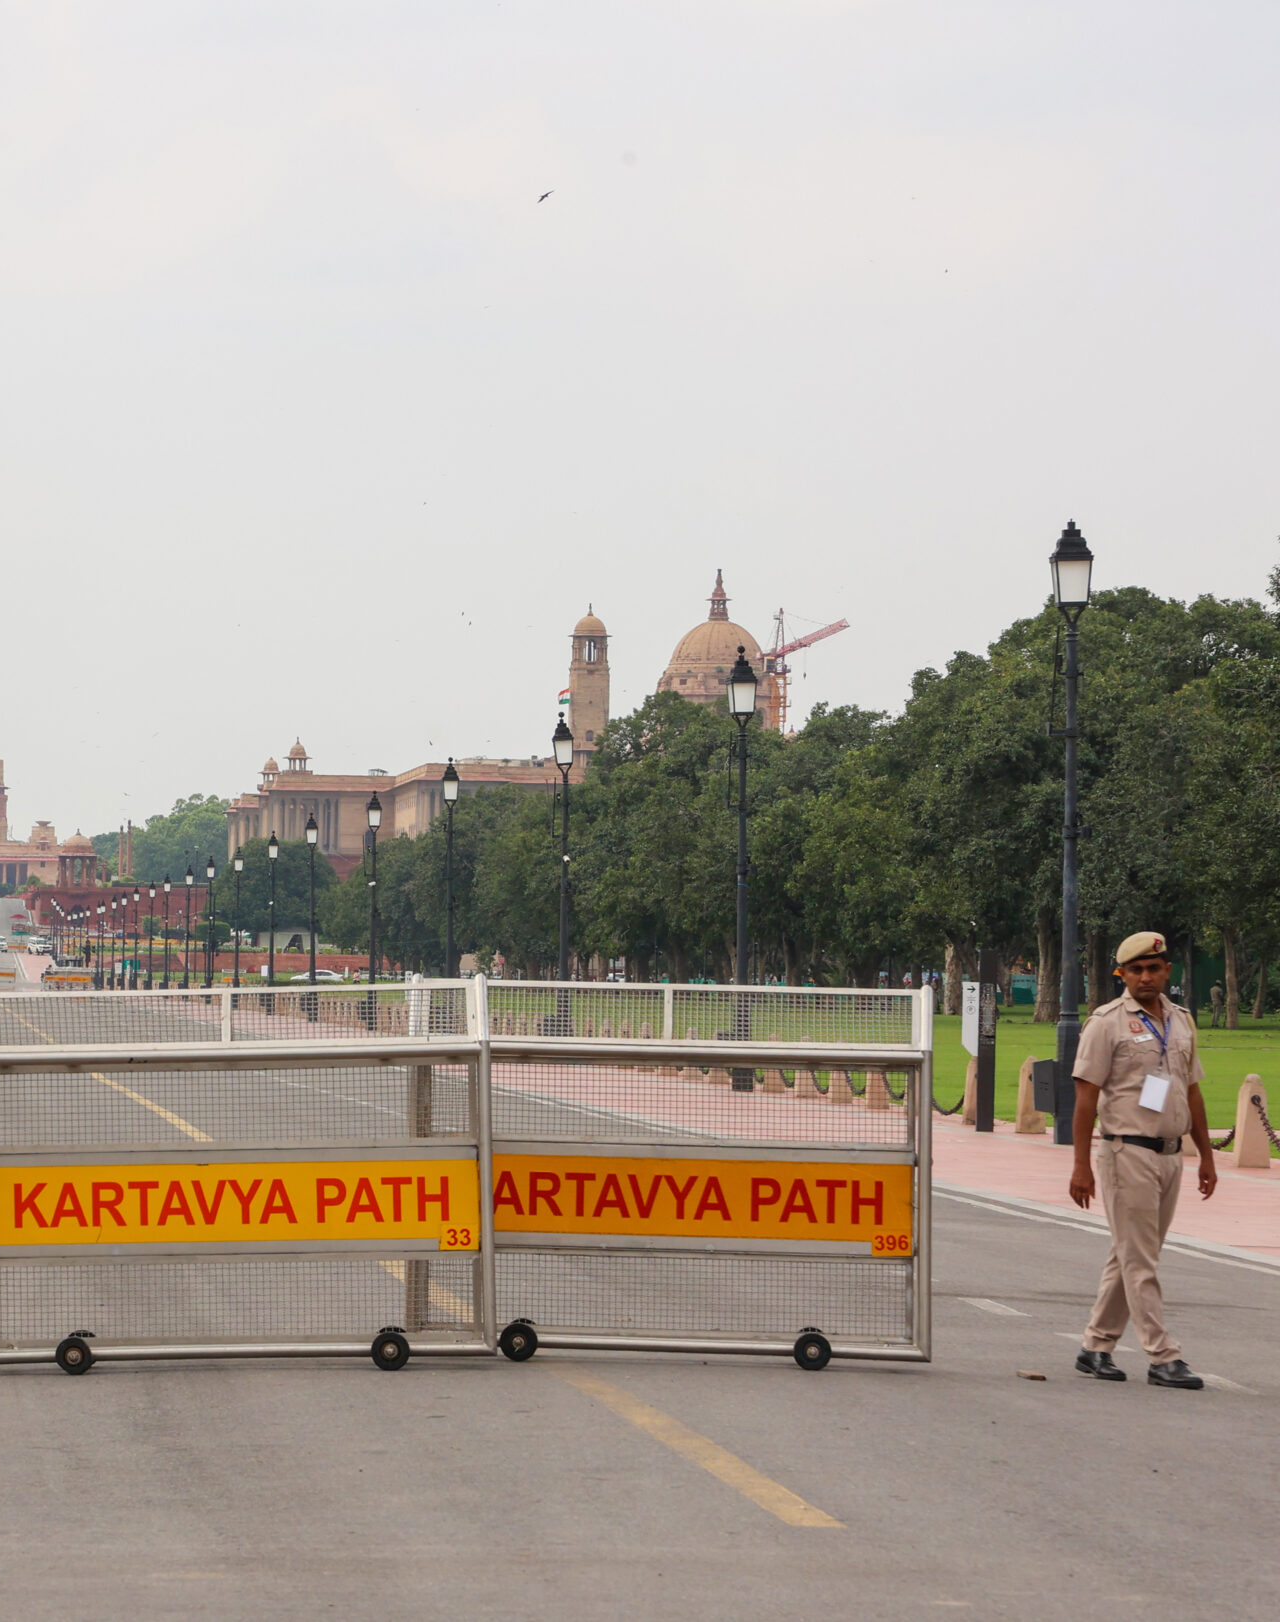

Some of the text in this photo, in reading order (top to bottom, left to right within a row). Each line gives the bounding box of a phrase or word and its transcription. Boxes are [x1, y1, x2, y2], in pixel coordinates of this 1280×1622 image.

[14, 1176, 450, 1228] KARTAVYA PATH
[493, 1171, 884, 1226] ARTAVYA PATH
[446, 1228, 472, 1246] 33
[874, 1234, 911, 1252] 396
